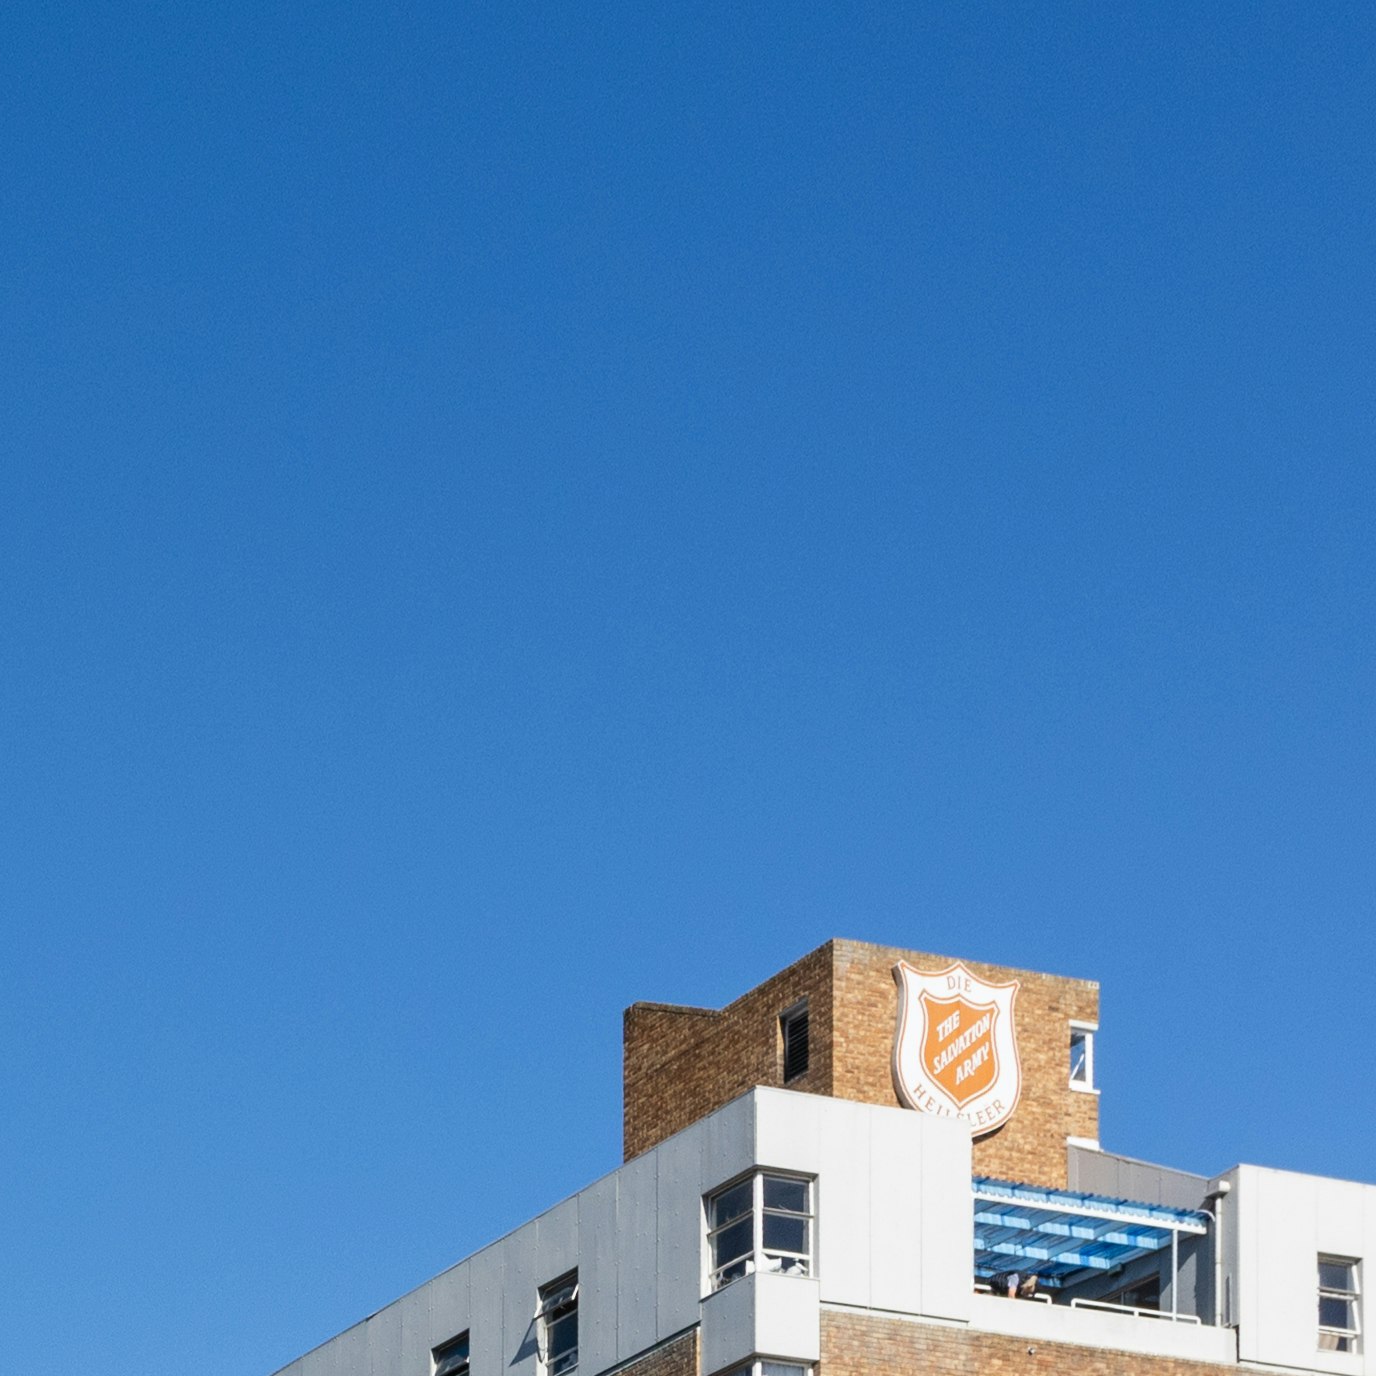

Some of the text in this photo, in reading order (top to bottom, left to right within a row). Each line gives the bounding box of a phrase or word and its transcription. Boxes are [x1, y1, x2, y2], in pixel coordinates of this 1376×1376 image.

[946, 975, 972, 993] DIE
[933, 1013, 990, 1074] SALVATION
[936, 1009, 961, 1042] THE
[955, 1041, 990, 1086] ARMY
